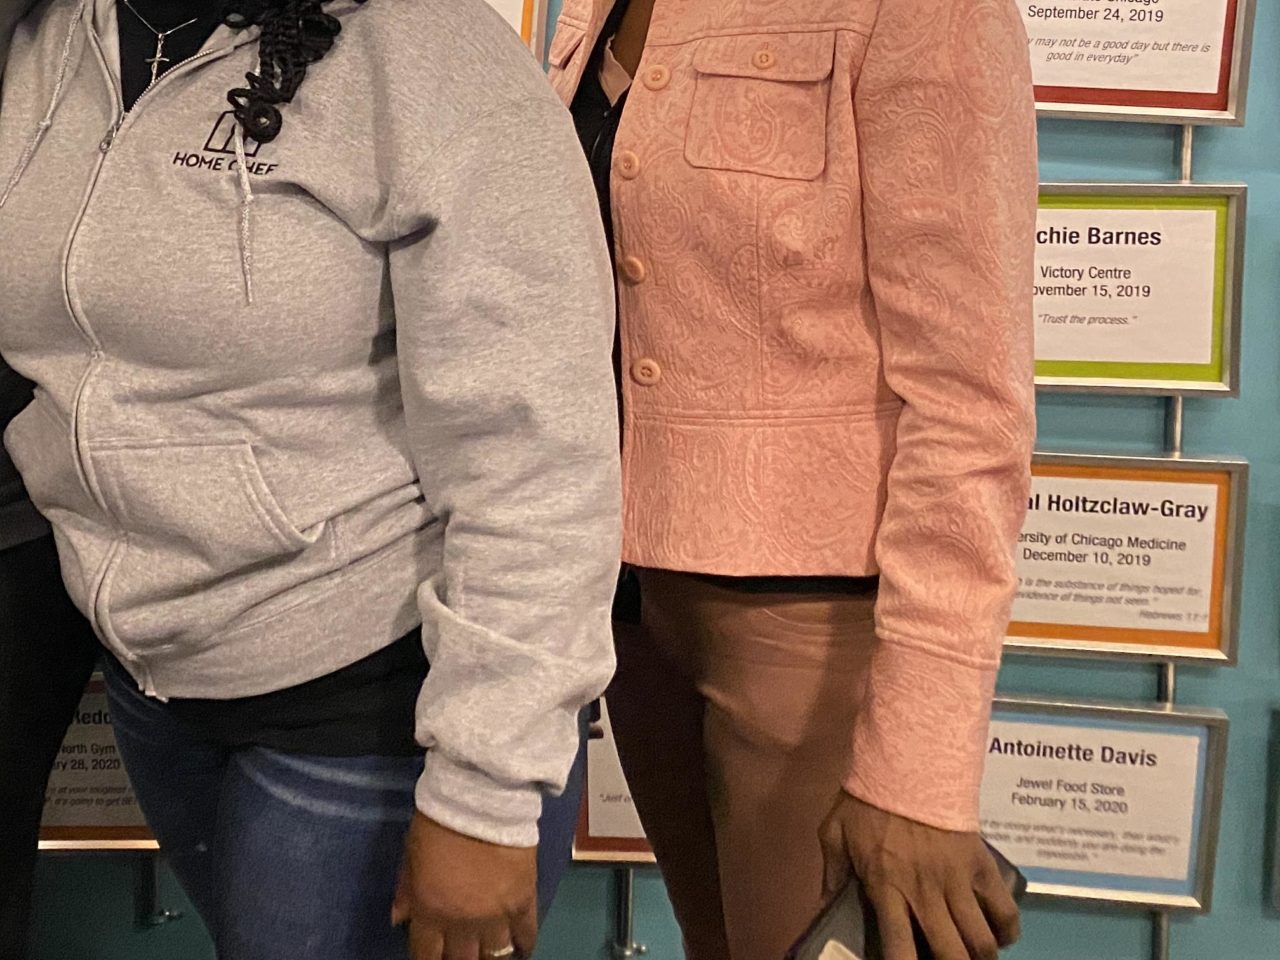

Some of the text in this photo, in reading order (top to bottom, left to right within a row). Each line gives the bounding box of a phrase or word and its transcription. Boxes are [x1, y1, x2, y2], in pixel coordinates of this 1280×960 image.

[1028, 5, 1164, 22] September 24, 2019
[173, 152, 225, 170] HOME
[1088, 227, 1161, 245] Barnes
[1040, 266, 1131, 281] Victory Centre
[1048, 494, 1208, 522] Holtzclaw-Gray
[1055, 533, 1186, 551] of Chicago Medicine
[989, 737, 1157, 766] Antoinette Davis
[1016, 777, 1125, 796] Jewel Food Store
